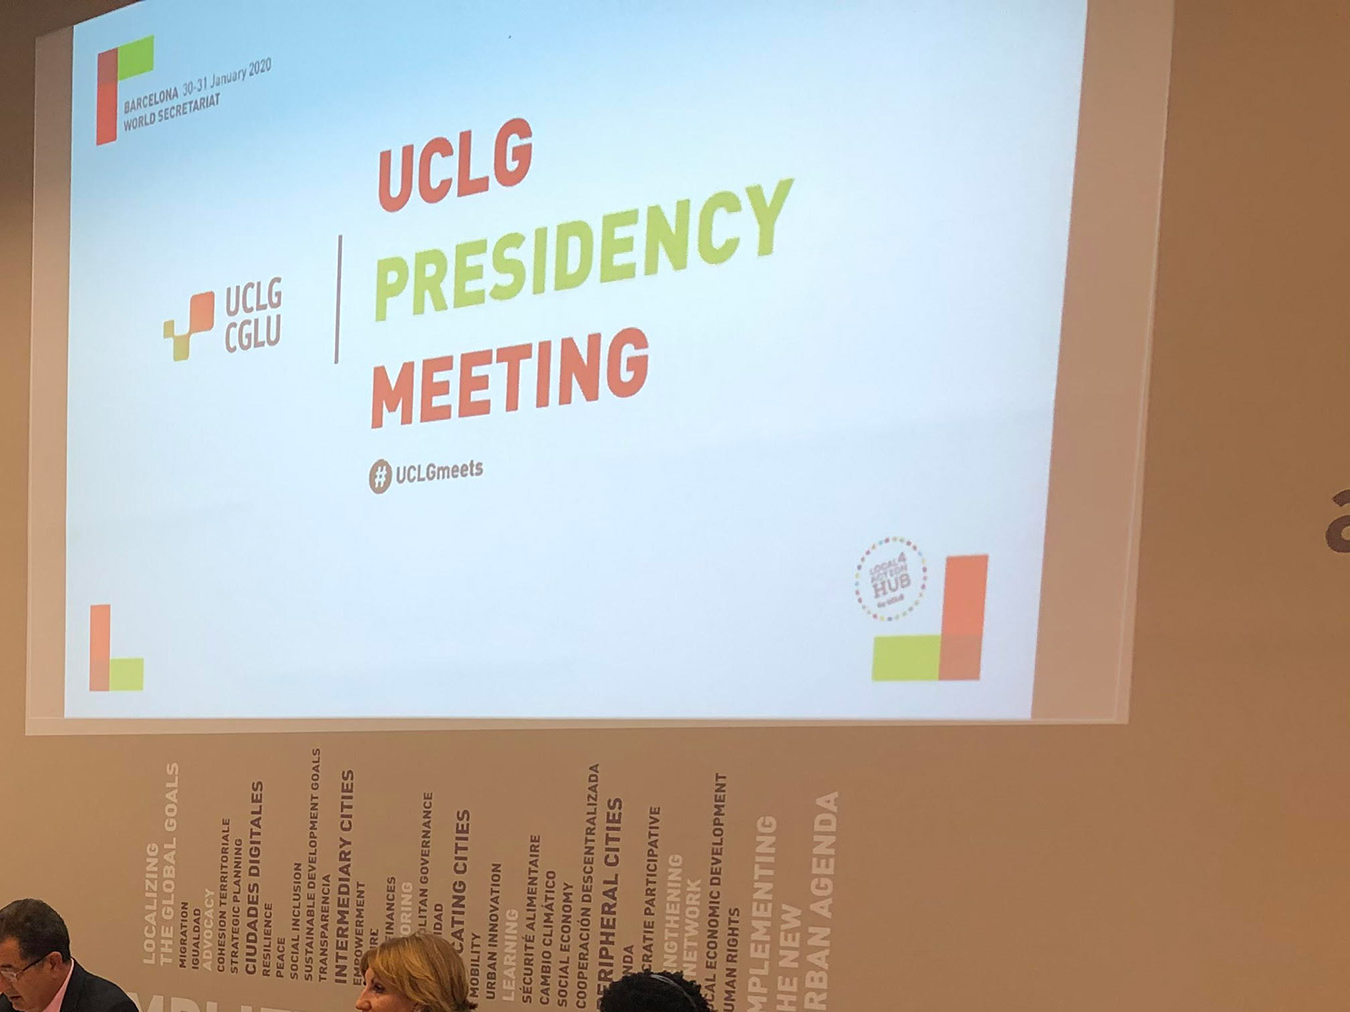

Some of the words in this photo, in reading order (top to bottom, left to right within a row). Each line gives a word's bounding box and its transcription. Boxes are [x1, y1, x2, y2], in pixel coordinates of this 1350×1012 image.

[123, 112, 156, 132] WORLD
[157, 92, 221, 123] SECRETARIAT
[124, 86, 179, 114] BARCELONA
[182, 76, 208, 97] 30-31
[210, 67, 247, 90] January
[249, 57, 272, 78] 2020
[378, 117, 534, 214] UCLG
[375, 177, 795, 323] PRESIDENCY
[226, 276, 282, 317] UCLG
[225, 313, 281, 353] CGLU
[371, 327, 650, 430] MEETING
[872, 573, 912, 599] HUB
[164, 761, 180, 832] GOALS
[310, 747, 321, 791] GOALS
[339, 769, 355, 832] CITIES
[219, 817, 231, 907] TERRITORIALE
[248, 780, 263, 877] DIGITALES
[307, 794, 320, 890] DEVELOPMENT
[420, 791, 433, 884] GOVERNANCE
[453, 809, 470, 875] CITIES
[581, 763, 599, 903] DESCENTRALIZADA
[604, 797, 623, 868] CITIES
[643, 806, 661, 916] PARTICIPATIVE
[710, 772, 727, 886] DEVELOPMENT
[809, 790, 839, 919] AGENDA
[143, 842, 159, 965] LOCALIZING
[161, 836, 177, 920] GLOBAL
[232, 838, 243, 903] PLANNING
[291, 862, 303, 932] INCLUSION
[488, 863, 501, 948] INNOVATION
[525, 834, 540, 931] ALIMENTAIRE
[178, 901, 189, 969] MIGRATION
[191, 908, 201, 970] IGUALDAD
[202, 888, 215, 972] ADVOCACY
[230, 905, 240, 974] STRATEGIC
[245, 882, 260, 976] CIUDADES
[262, 902, 273, 977] RESILIENCE
[304, 892, 316, 981] SUSTAINABLE
[318, 873, 331, 983] TRANSPARENCIA
[334, 836, 353, 984] INTERMEDIARY
[353, 881, 366, 986] EMPOWERMENT
[399, 881, 413, 938] ORING
[433, 903, 444, 936] IDAD
[541, 870, 556, 947] CLIMÁTICO
[559, 882, 574, 953] ECONOMY
[682, 878, 701, 977] NETWORK
[705, 890, 721, 969] ECONOMIC
[726, 907, 740, 963] RIGHTS
[778, 903, 802, 969] NEW
[160, 925, 174, 967] THE
[275, 937, 286, 979] PEACE
[290, 934, 300, 980] SOCIAL
[469, 932, 481, 998] MOBILITY
[485, 951, 498, 1000] URBAN
[502, 908, 519, 1002] LEARNING
[519, 934, 535, 1004] SÉCURITÉ
[539, 950, 552, 1006] CAMBIO
[575, 907, 592, 1009] COOPERACIÓN
[557, 956, 570, 1008] SOCIAL
